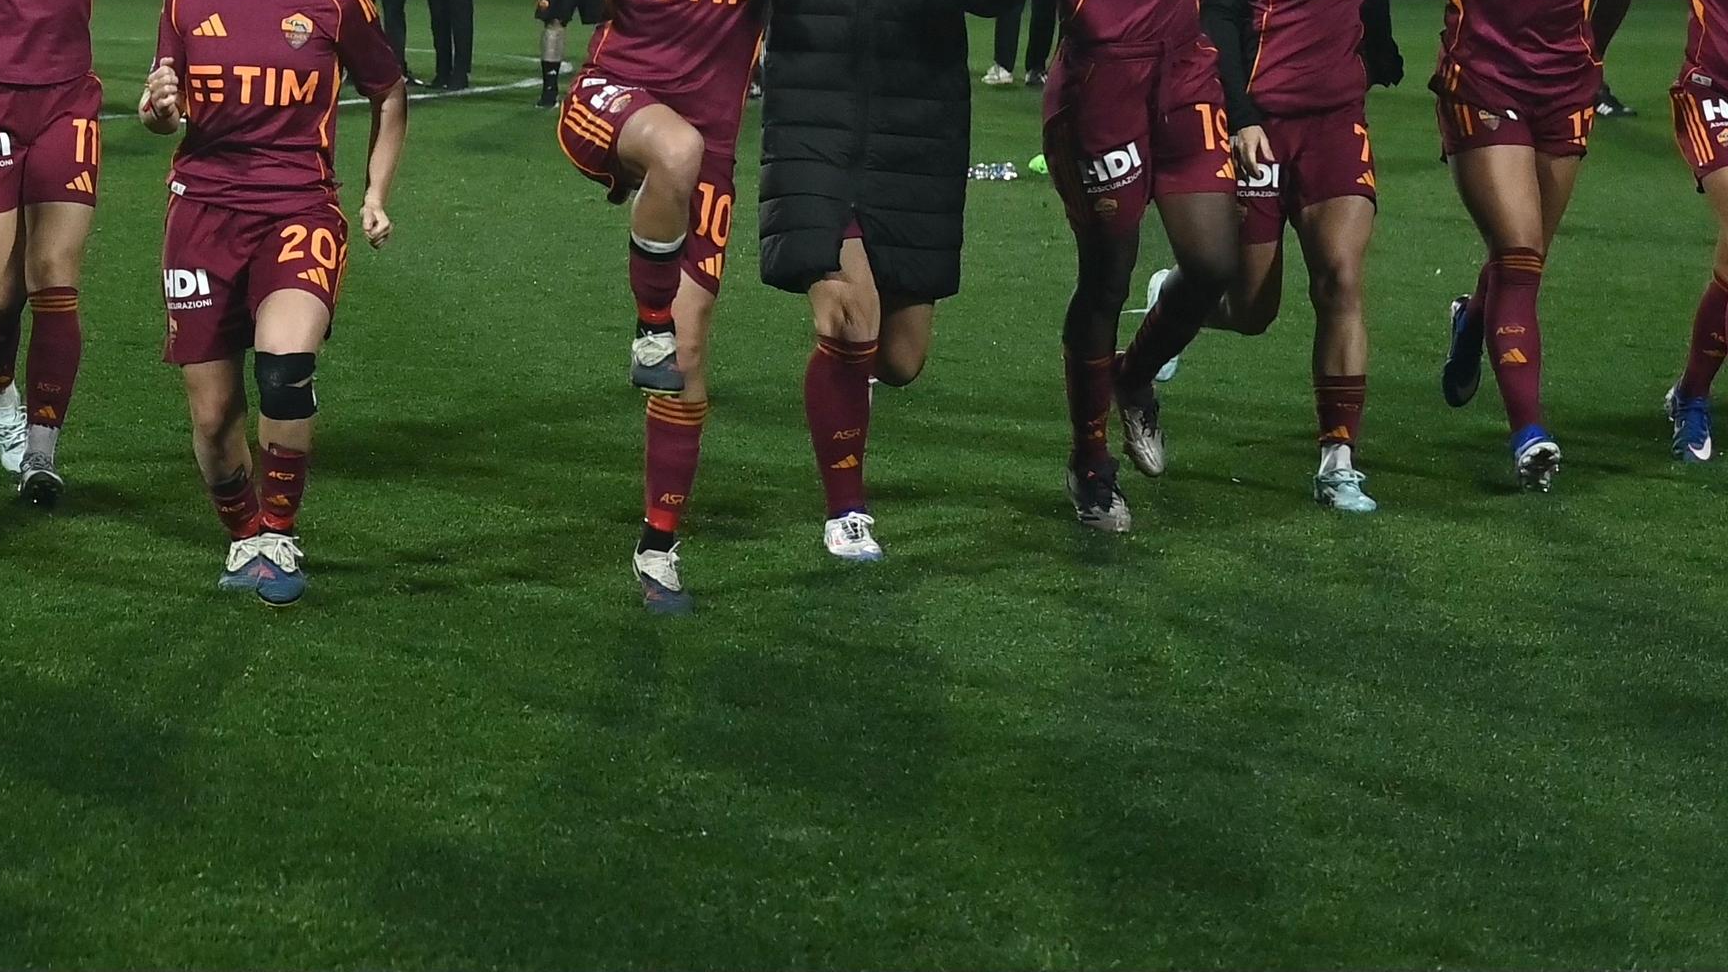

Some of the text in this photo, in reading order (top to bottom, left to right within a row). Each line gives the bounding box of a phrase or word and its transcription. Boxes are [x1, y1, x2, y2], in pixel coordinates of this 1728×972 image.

[232, 65, 319, 106] TIM
[72, 118, 97, 165] 11
[1195, 104, 1231, 153] 19
[1237, 163, 1280, 188] DI
[695, 182, 731, 247] 10
[278, 224, 337, 270] 20
[163, 269, 210, 297] HDI
